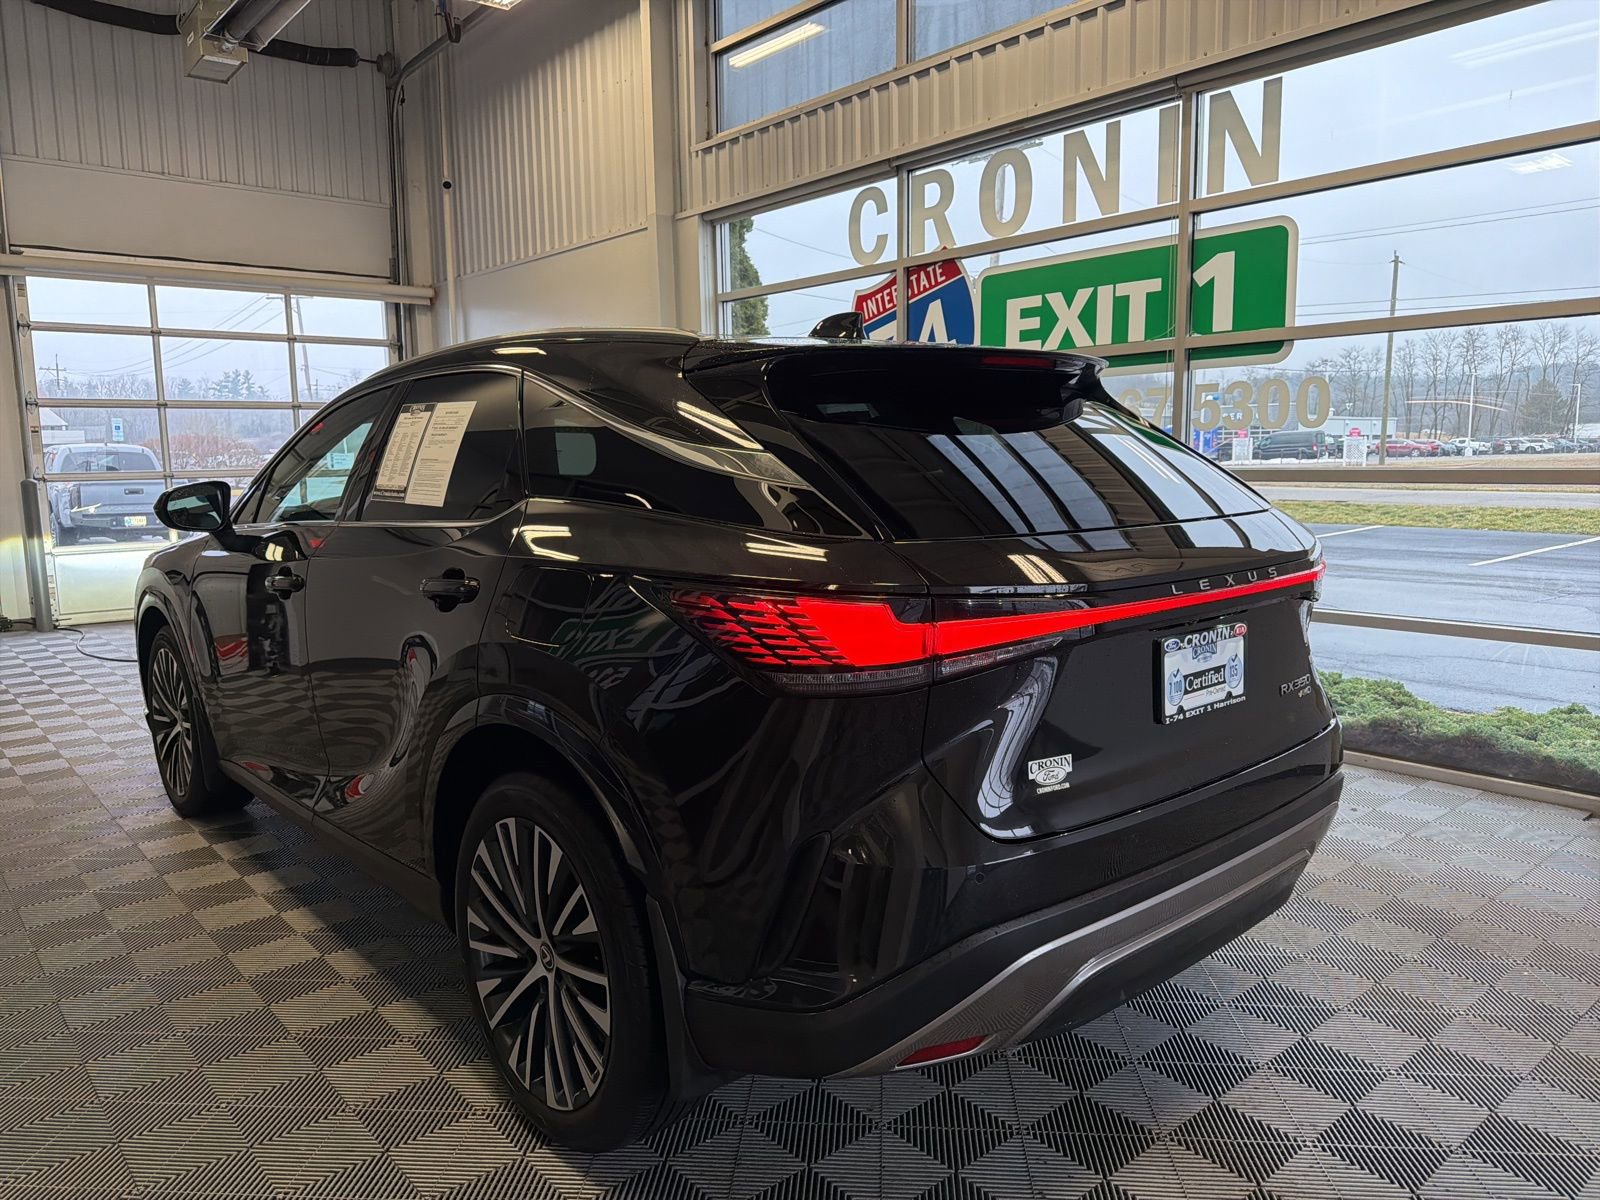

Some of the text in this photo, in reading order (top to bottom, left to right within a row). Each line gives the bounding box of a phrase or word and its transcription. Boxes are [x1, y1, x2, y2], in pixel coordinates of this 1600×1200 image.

[848, 76, 1283, 266] CRONIN
[1005, 250, 1236, 350] EXIT 1
[1191, 376, 1331, 431] 5300
[1172, 567, 1278, 595] LEXUS
[1184, 627, 1230, 648] CRONIN
[1186, 668, 1224, 691] Certified
[1165, 696, 1246, 725] I-74 EXIT 1 Harrison
[1029, 756, 1071, 775] CRONIN
[1042, 769, 1062, 782] Ford
